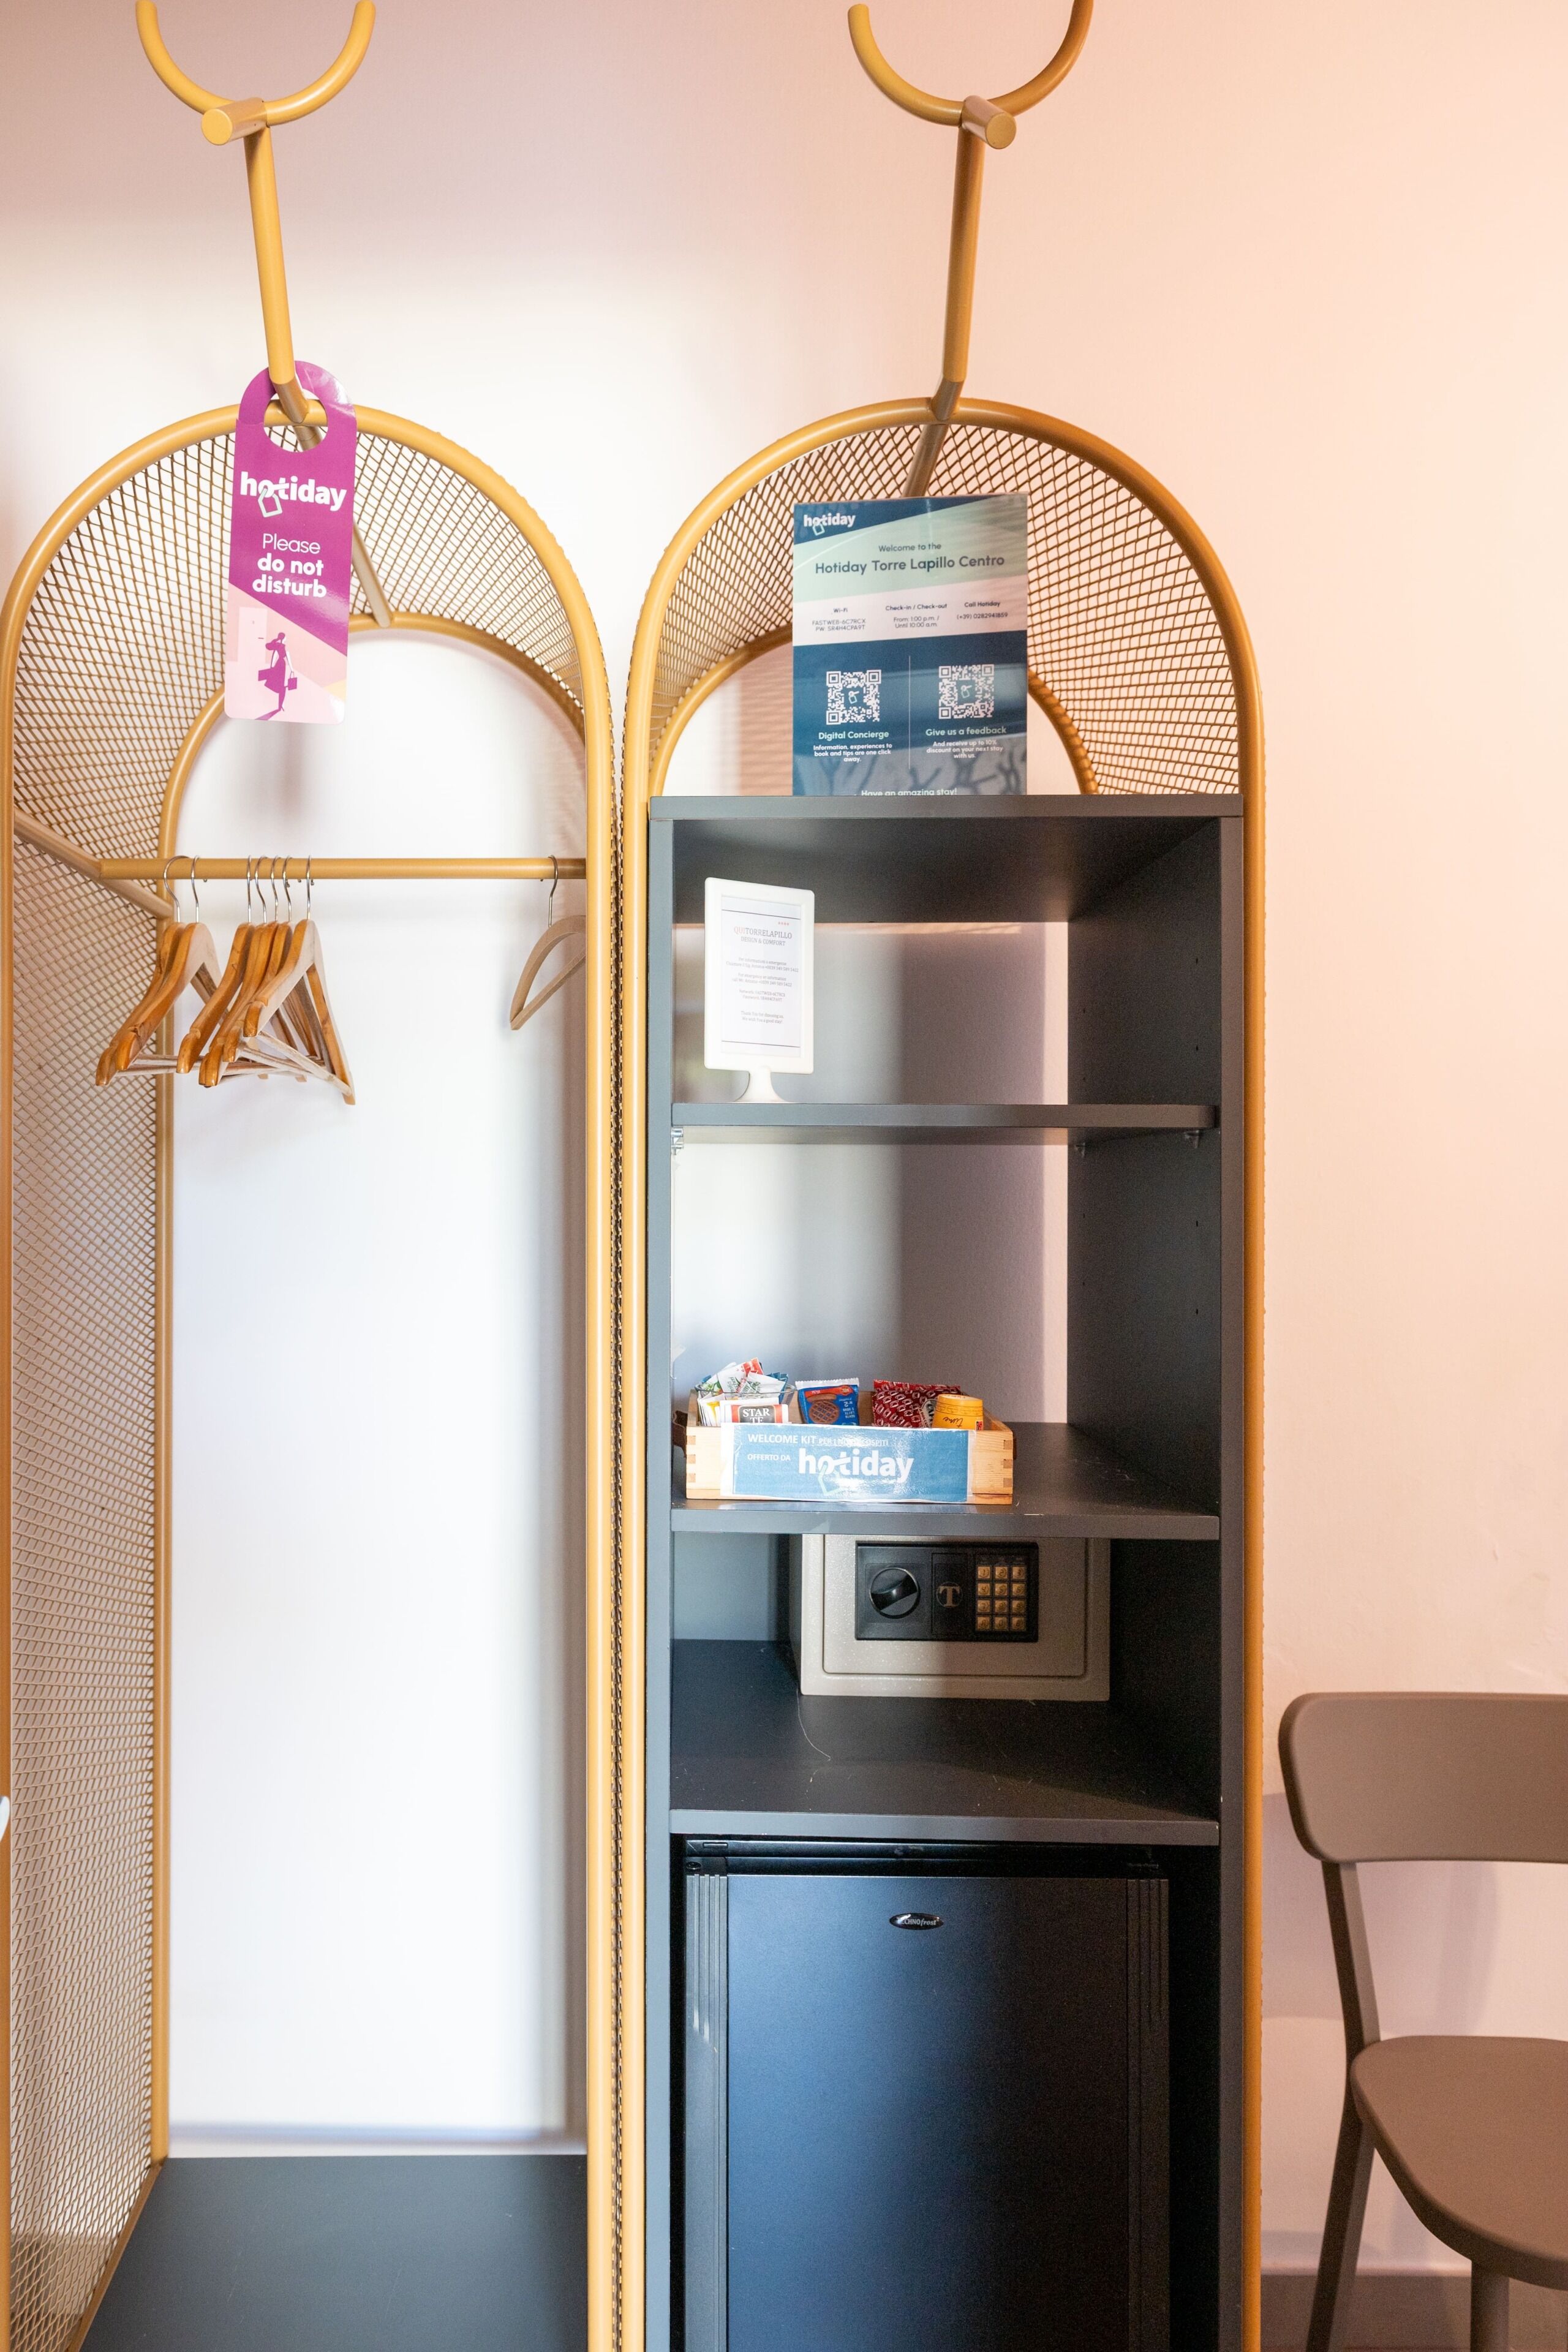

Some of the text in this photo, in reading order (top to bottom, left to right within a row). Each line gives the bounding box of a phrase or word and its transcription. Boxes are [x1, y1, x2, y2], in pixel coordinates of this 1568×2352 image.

[240, 471, 347, 511] hotiday
[804, 513, 856, 528] hotiday
[263, 533, 320, 554] Please
[879, 543, 915, 552] Welcome
[257, 552, 324, 576] do not
[815, 555, 1005, 575] Hotiday Torre Lapillo Centro
[252, 574, 326, 598] disturb
[818, 731, 889, 741] Digital Concierge
[966, 726, 1006, 735] feedback
[742, 1408, 771, 1417] STAR
[748, 1434, 798, 1444] WELCOME
[801, 1434, 816, 1444] KIT
[798, 1448, 914, 1483] hotiday
[939, 1585, 960, 1607] T
